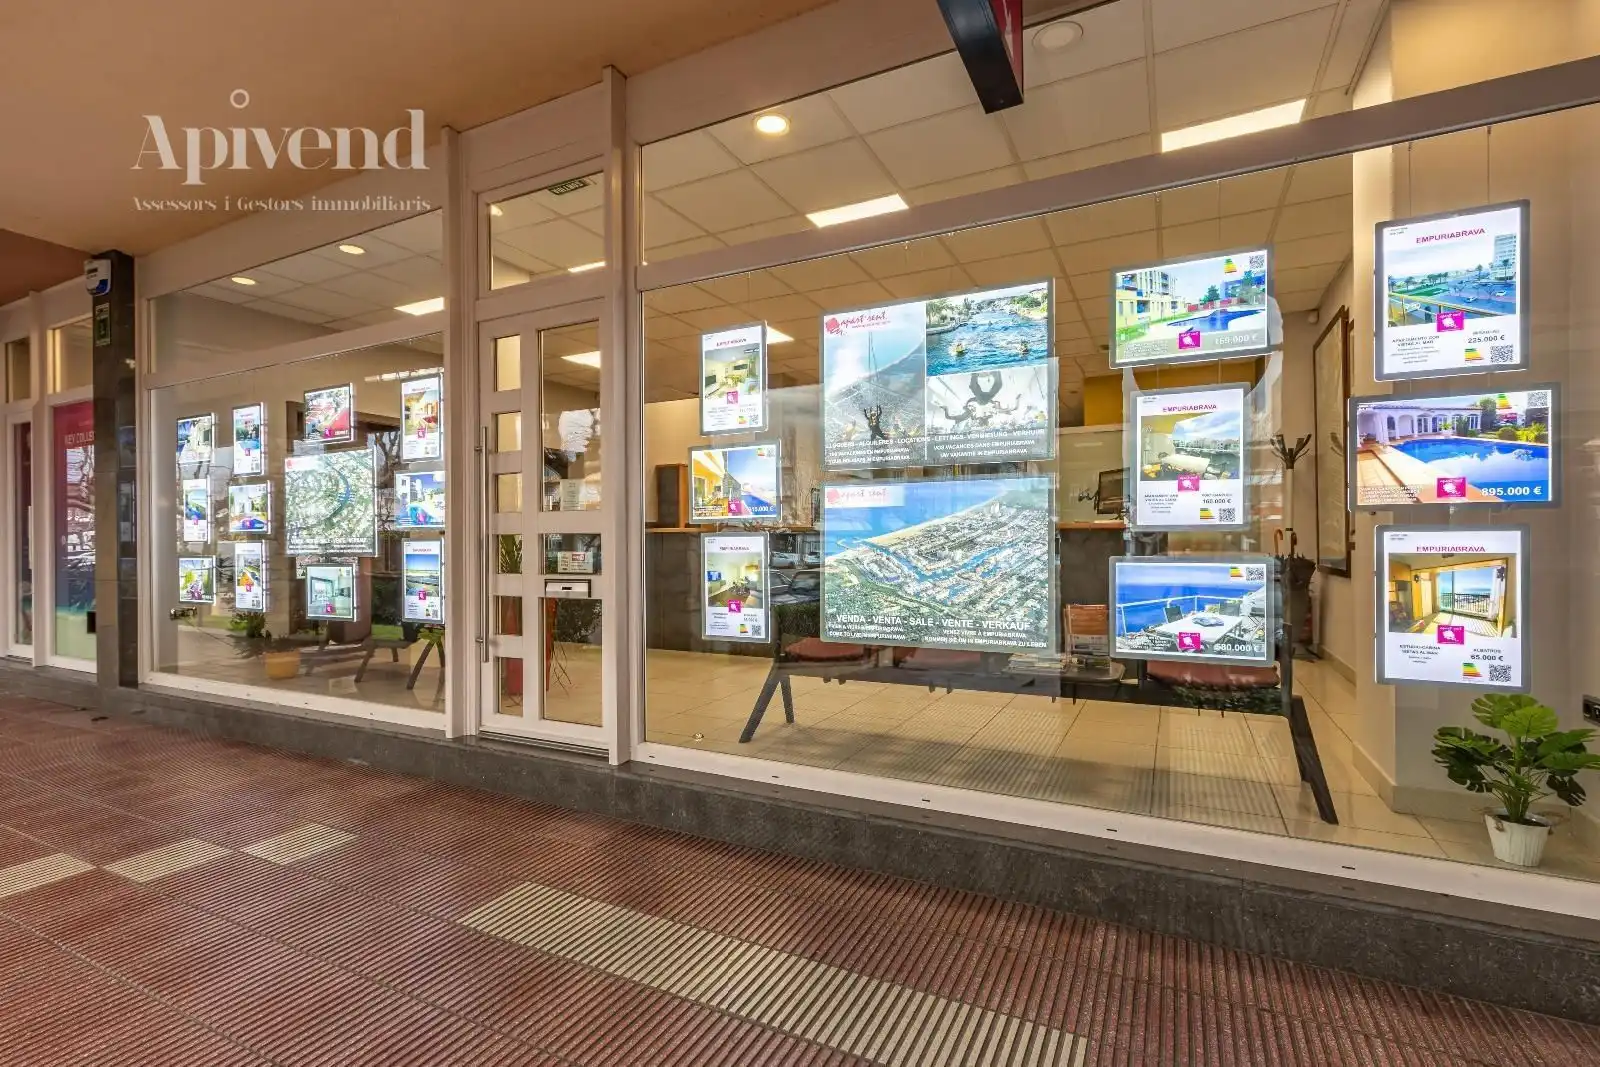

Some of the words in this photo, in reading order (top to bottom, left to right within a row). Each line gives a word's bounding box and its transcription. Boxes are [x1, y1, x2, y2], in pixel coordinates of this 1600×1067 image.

[1416, 228, 1486, 243] EMPURIABRAVA
[1467, 335, 1498, 344] 225.000
[1162, 404, 1217, 413] EMPURIABRAVA
[1481, 486, 1530, 496] 895.000
[1533, 486, 1542, 495] €
[836, 614, 866, 623] VENDA
[873, 616, 902, 625] VENTA
[909, 617, 934, 626] SALE
[942, 619, 974, 628] VENTE
[982, 620, 1031, 630] VERKAUF
